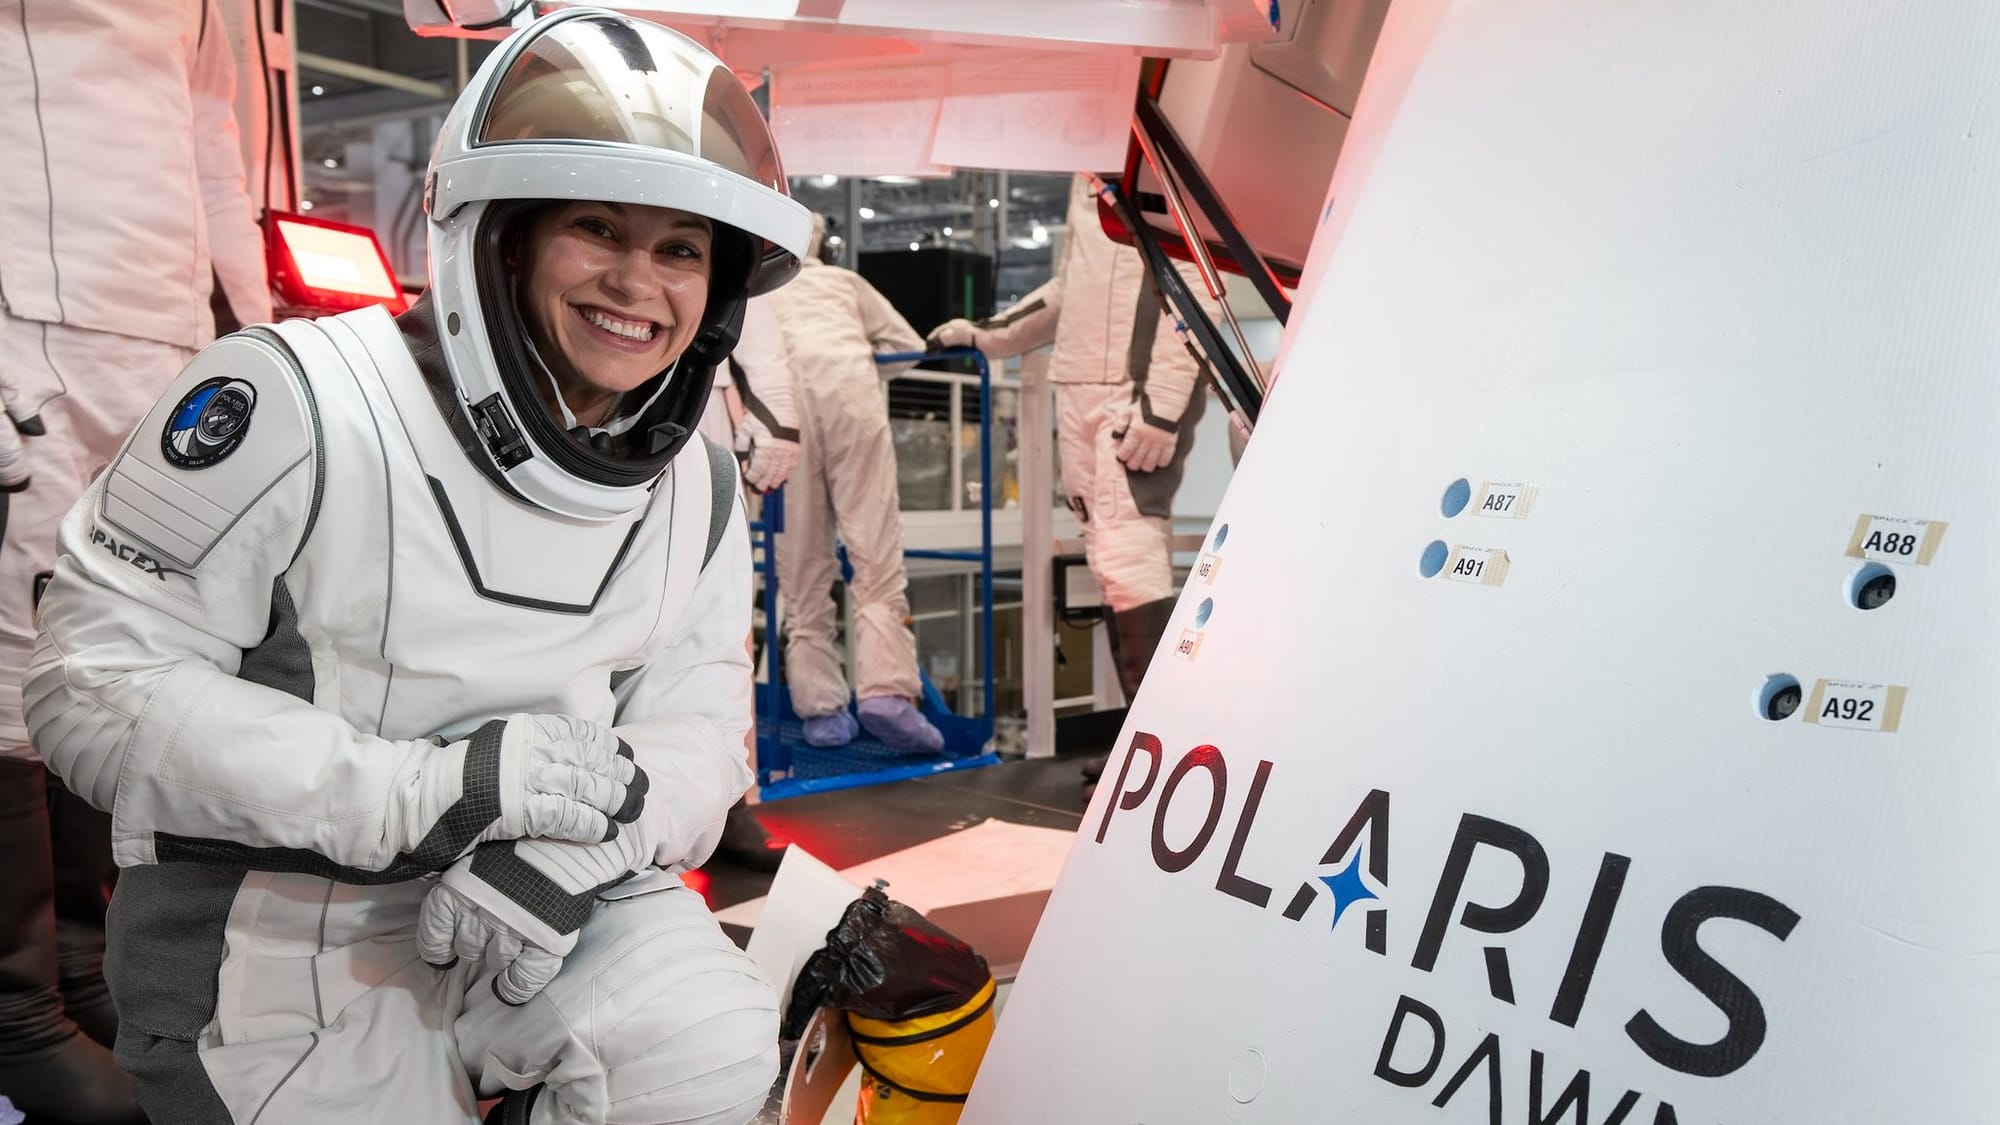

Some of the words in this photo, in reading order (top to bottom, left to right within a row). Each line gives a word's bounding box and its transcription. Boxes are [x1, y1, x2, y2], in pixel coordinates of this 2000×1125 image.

[1482, 493, 1516, 512] A87
[1864, 530, 1917, 556] A88
[1453, 557, 1485, 577] A91
[1821, 697, 1875, 722] A92
[1095, 731, 1802, 1078] POLARIS
[1373, 994, 1680, 1125] DAW
